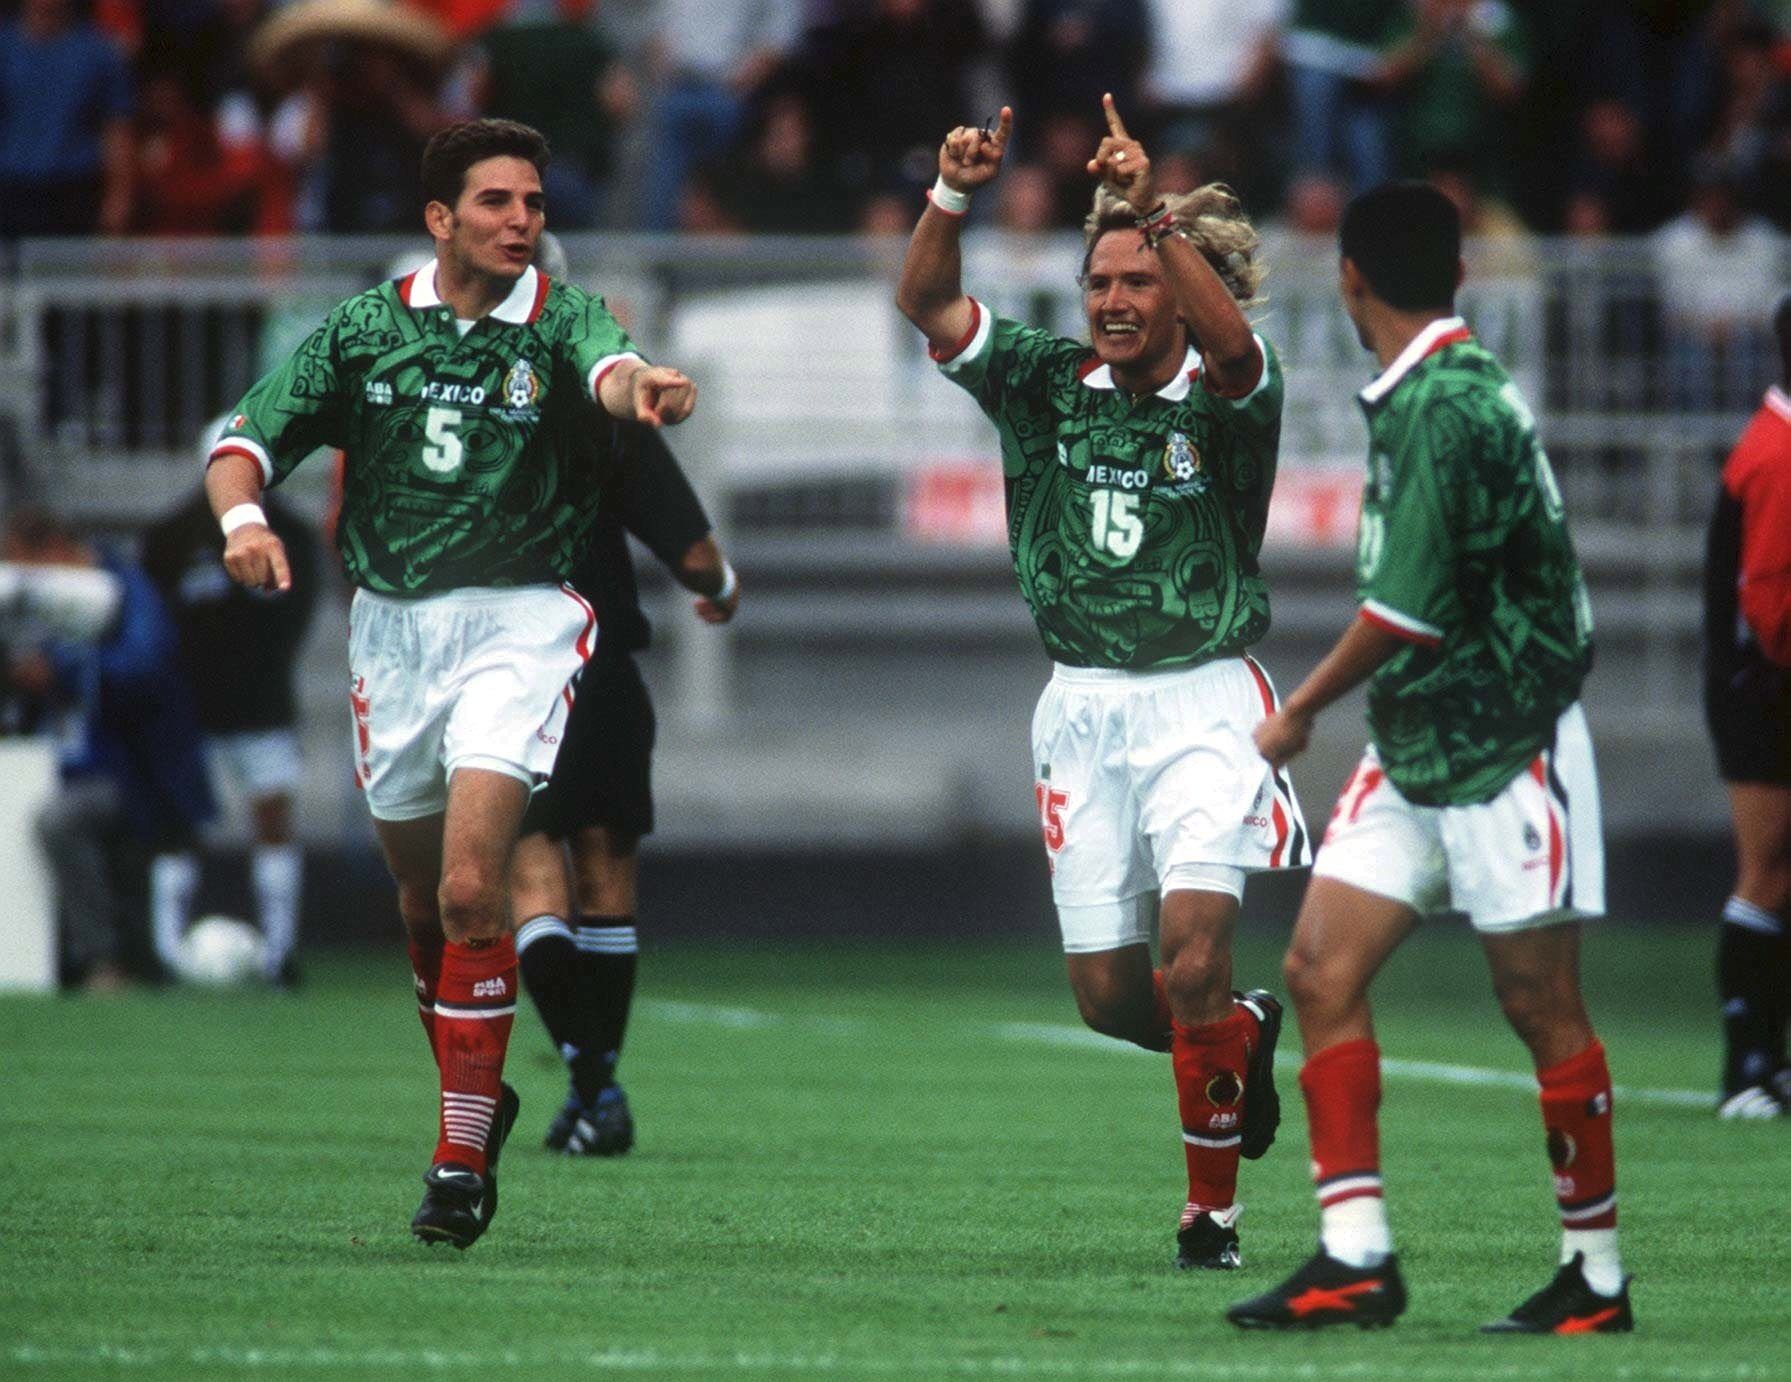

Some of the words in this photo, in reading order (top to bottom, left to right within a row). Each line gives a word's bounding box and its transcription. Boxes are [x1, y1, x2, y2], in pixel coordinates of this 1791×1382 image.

[366, 381, 392, 395] ABA
[422, 407, 463, 472] 5
[1090, 489, 1143, 557] 15
[1034, 783, 1070, 854] 15
